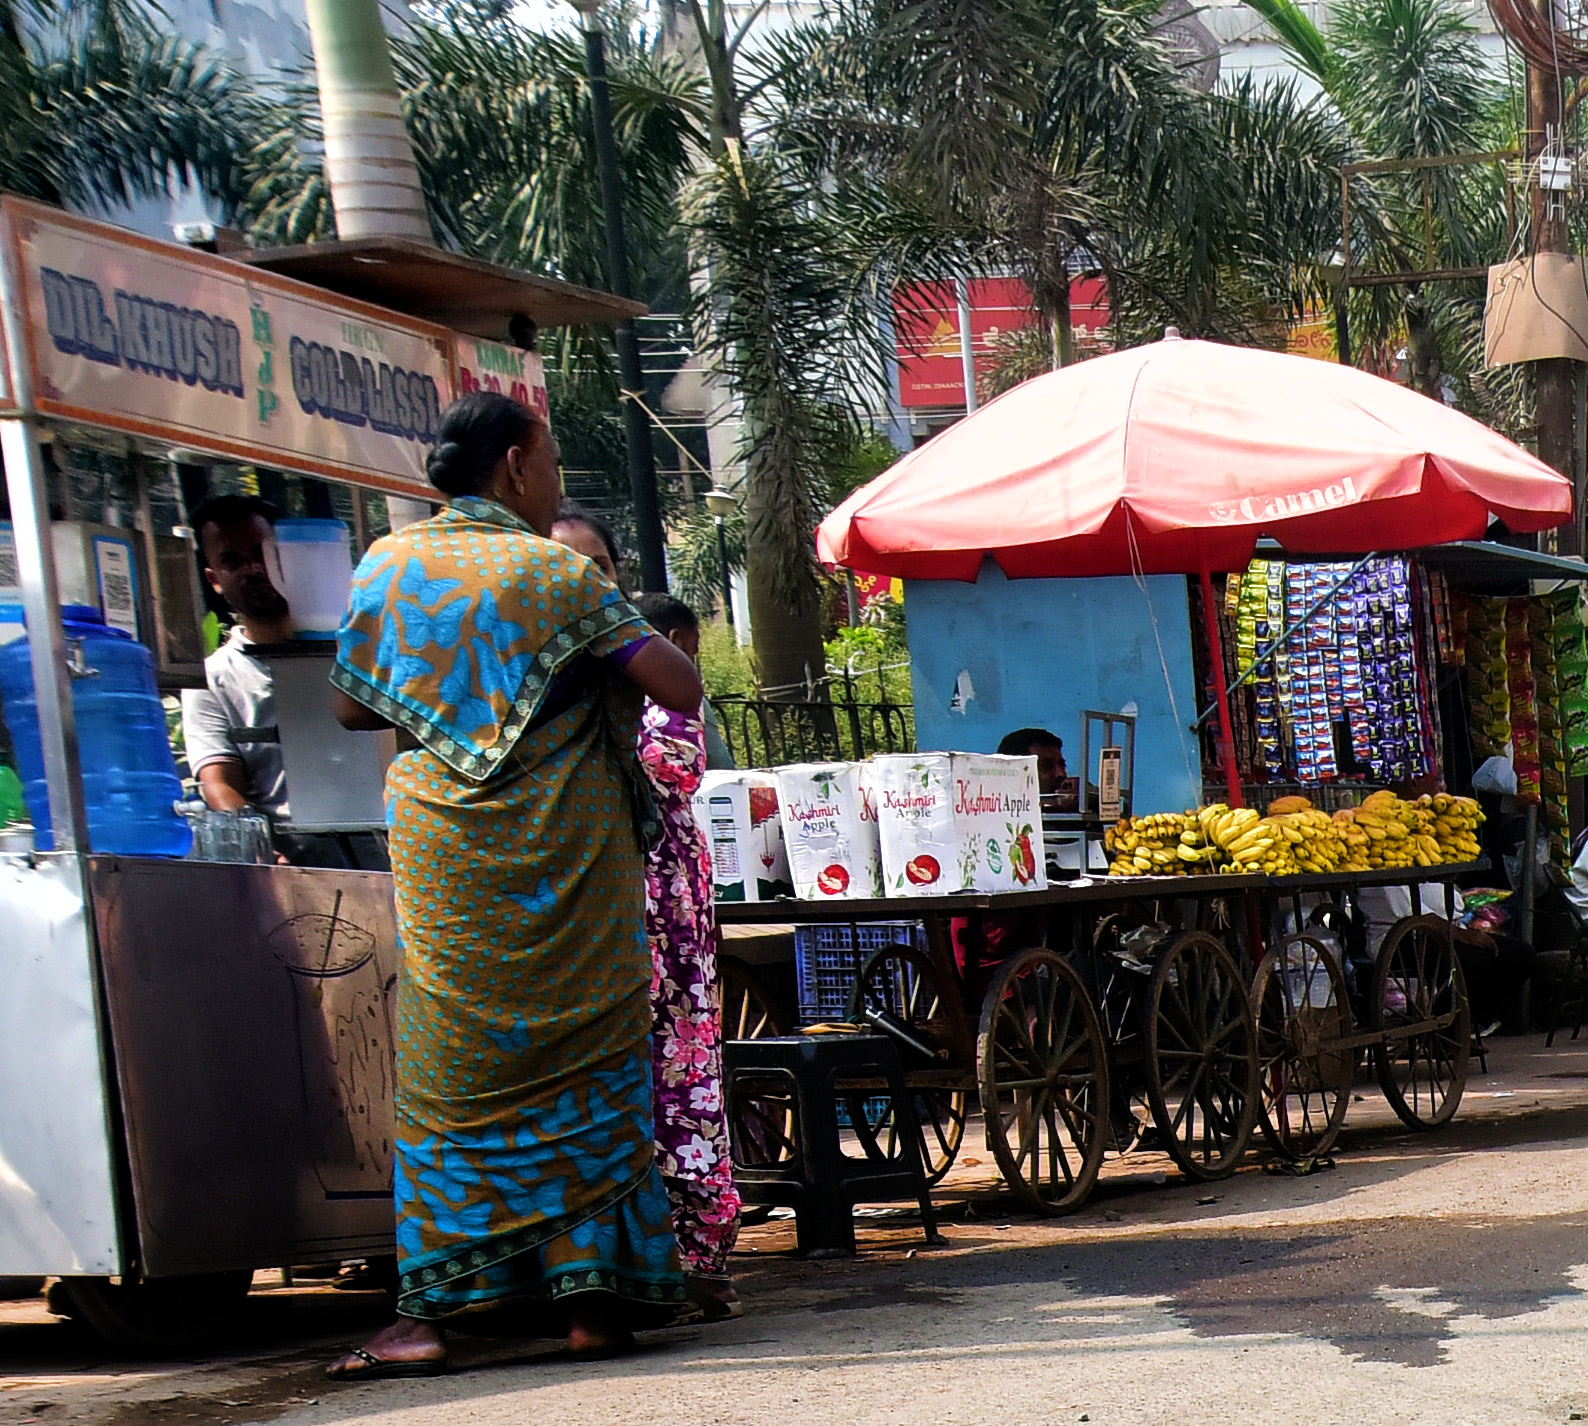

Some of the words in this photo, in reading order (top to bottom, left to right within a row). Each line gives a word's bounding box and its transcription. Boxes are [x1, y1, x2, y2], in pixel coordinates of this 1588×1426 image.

[40, 266, 121, 368] DIL
[114, 288, 245, 399] KHUSH
[290, 335, 367, 428] COLD
[1240, 476, 1357, 520] Camel
[787, 803, 841, 823] Kashmiri
[883, 790, 937, 809] Kashmiri
[956, 779, 1003, 817] Kashmiri
[1004, 793, 1031, 818] Apple
